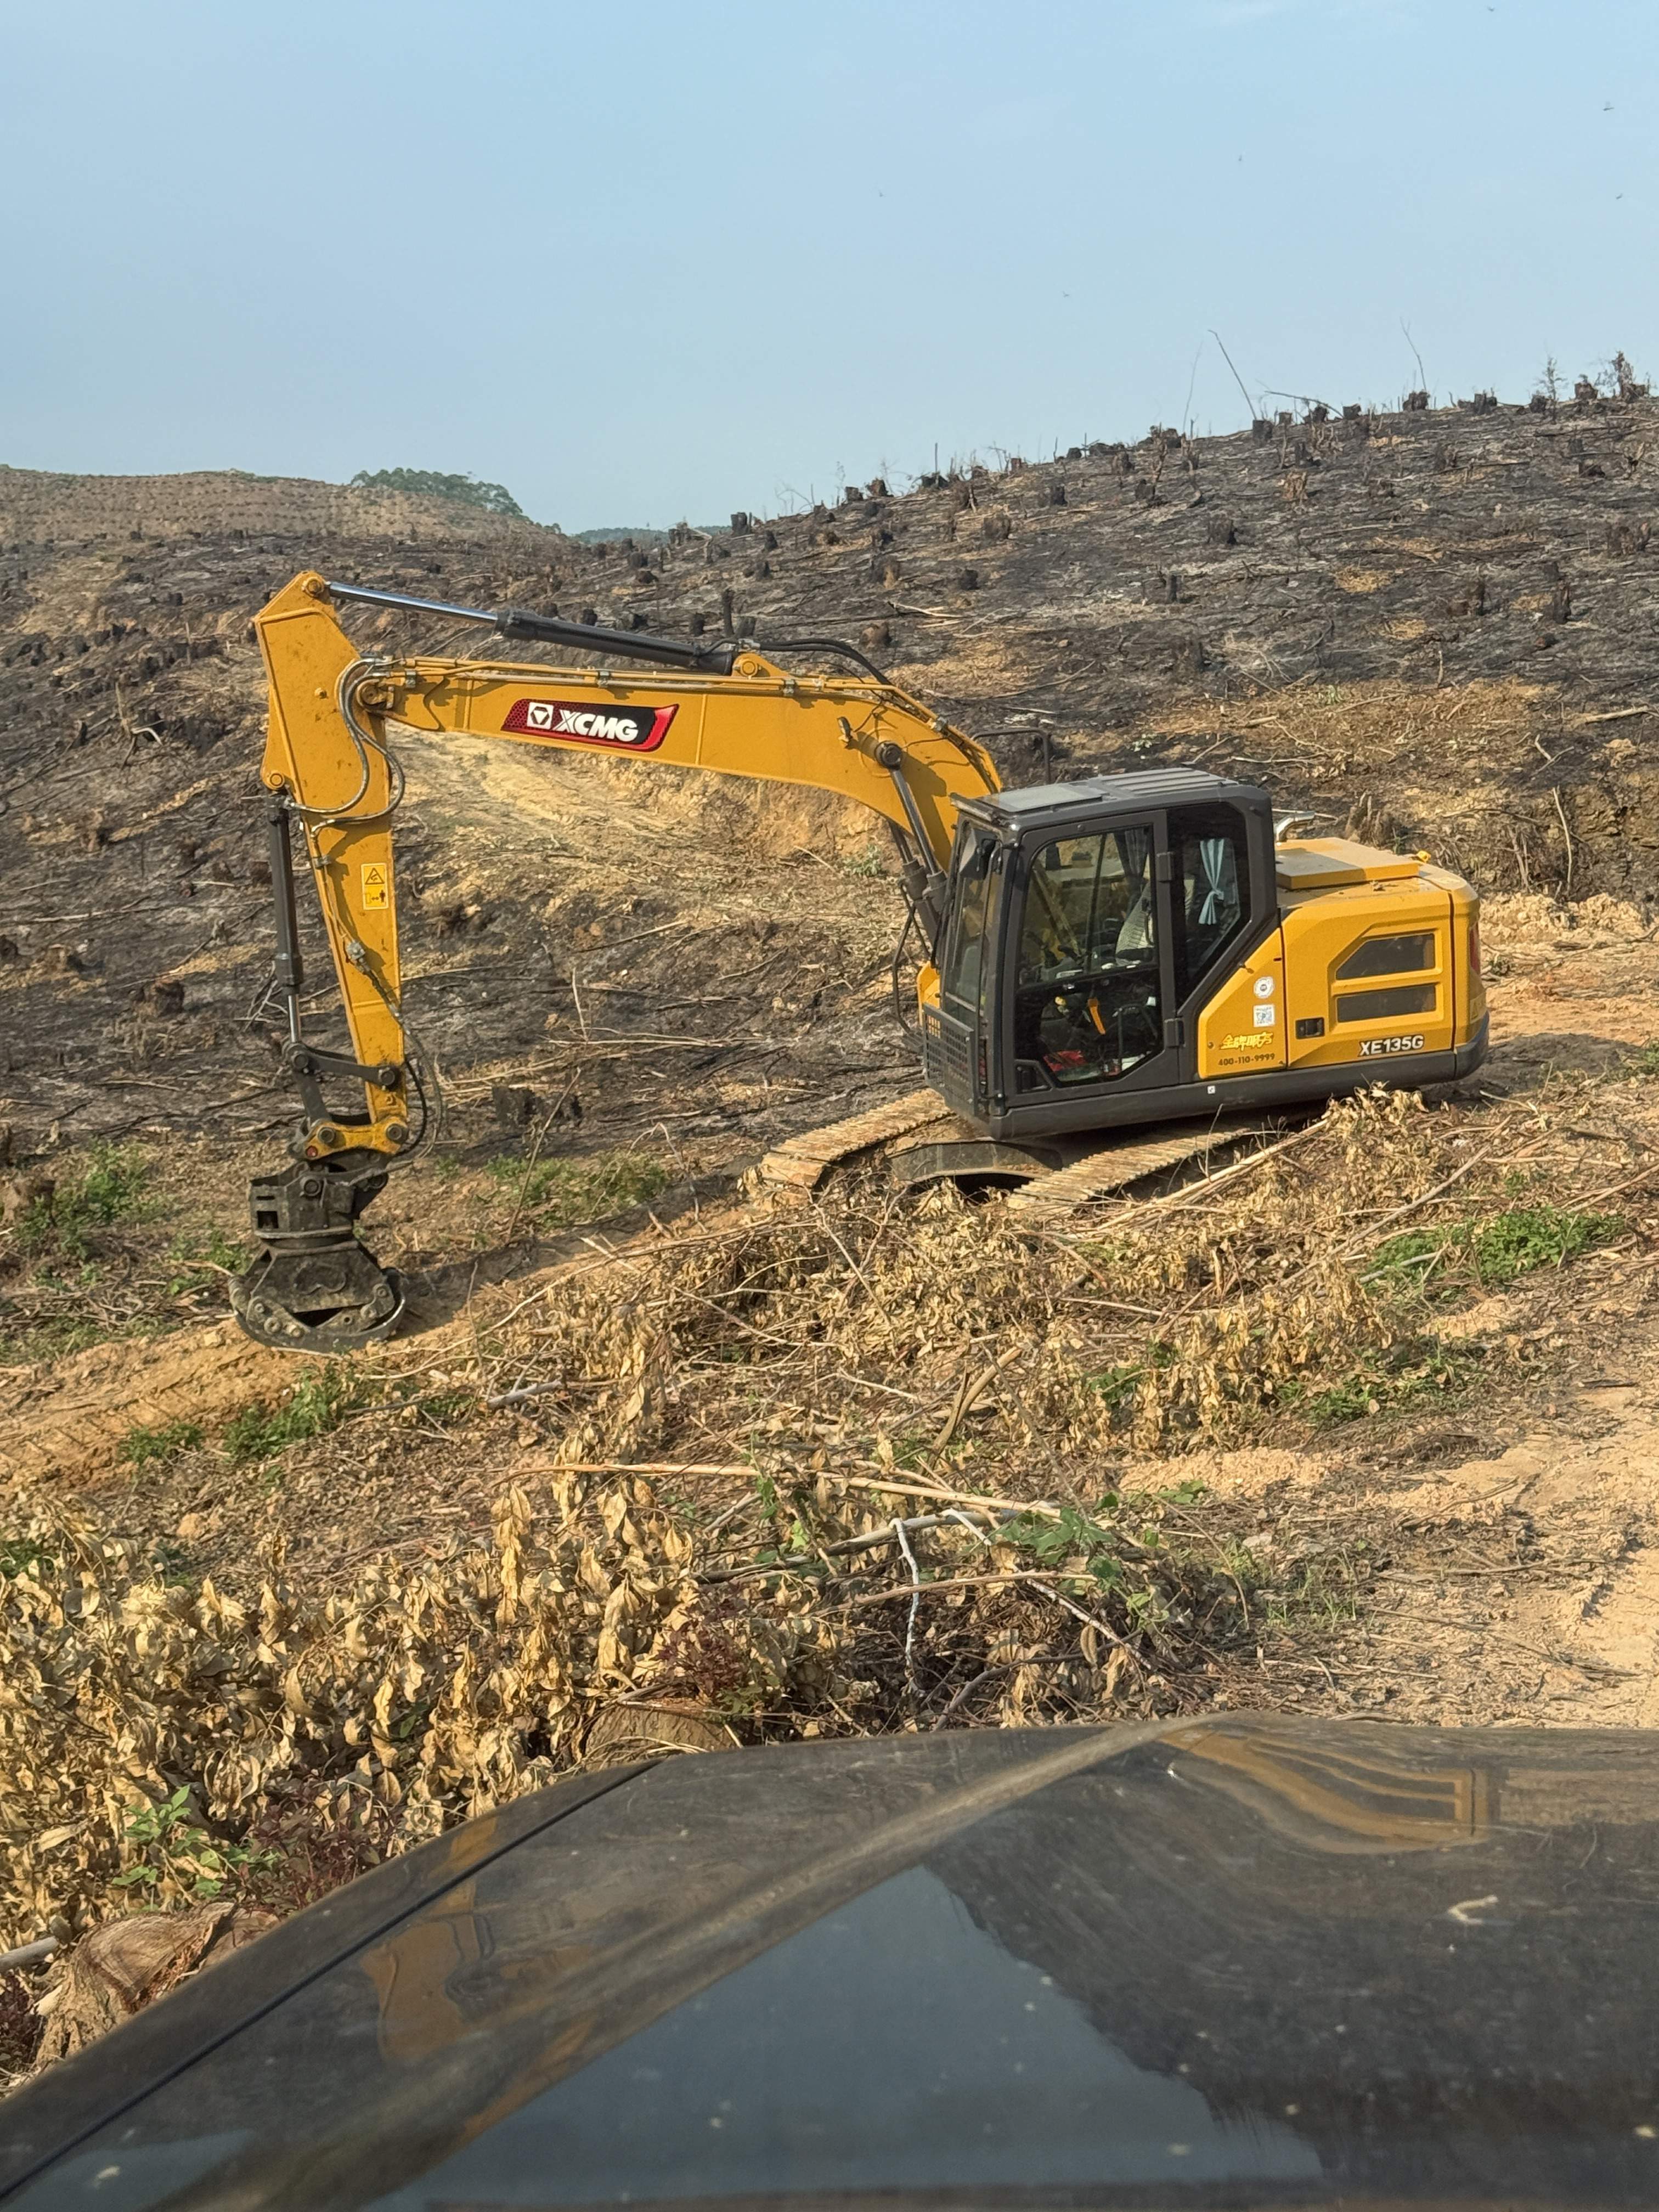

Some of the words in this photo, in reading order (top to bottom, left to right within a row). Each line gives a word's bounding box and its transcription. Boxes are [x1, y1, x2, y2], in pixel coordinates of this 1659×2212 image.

[553, 709, 639, 742] XCMG
[1359, 1035, 1424, 1056] XE135G
[1218, 1053, 1276, 1065] 400-110-9999
